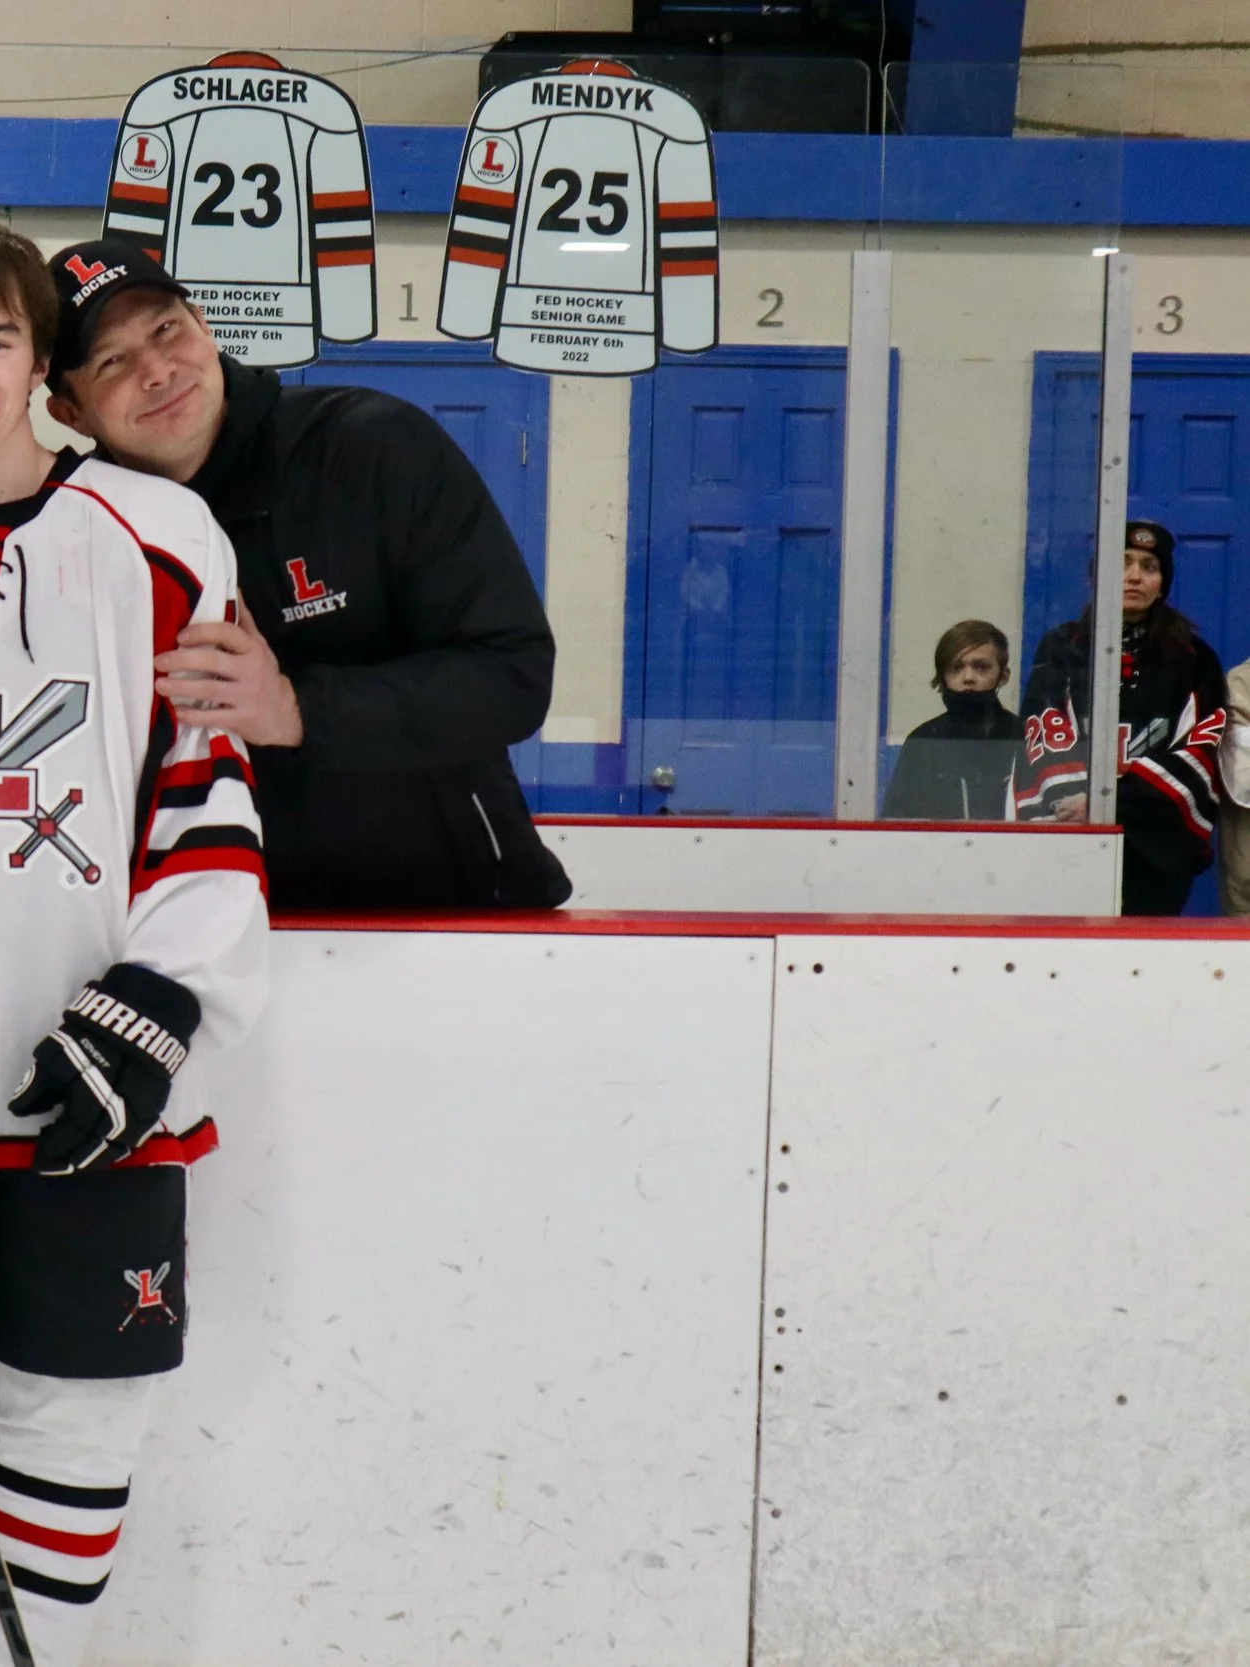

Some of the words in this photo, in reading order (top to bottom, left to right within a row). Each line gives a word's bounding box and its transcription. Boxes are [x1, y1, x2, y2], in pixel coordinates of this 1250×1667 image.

[172, 76, 308, 103] SCHLAGER
[531, 82, 654, 112] MENDYK
[134, 137, 156, 167] L
[483, 141, 504, 171] L
[129, 166, 158, 175] HOCKEY
[477, 169, 505, 178] HOCKEY
[191, 162, 283, 228] 23
[536, 167, 629, 236] 25
[64, 253, 107, 285] L
[72, 264, 128, 307] HOCKEY
[192, 290, 219, 300] FED
[223, 290, 281, 301] HOCKEY
[199, 305, 240, 316] ENIOR
[244, 306, 284, 317] GAME
[399, 282, 419, 321] 1
[536, 295, 561, 306] FED
[565, 297, 623, 309] HOCKEY
[757, 288, 784, 328] 2
[1155, 295, 1183, 335] 3
[531, 311, 583, 323] SENIOR
[586, 313, 626, 325] GAME
[210, 329, 258, 340] RUARY
[262, 330, 282, 341] 6th
[221, 345, 248, 355] 2022
[530, 333, 600, 347] FEBRUARY
[603, 337, 624, 348] 6th
[562, 351, 589, 362] 2022
[286, 556, 327, 603] L
[281, 591, 347, 623] HOCKEY
[1024, 707, 1078, 766] 28
[138, 1269, 162, 1308] L
